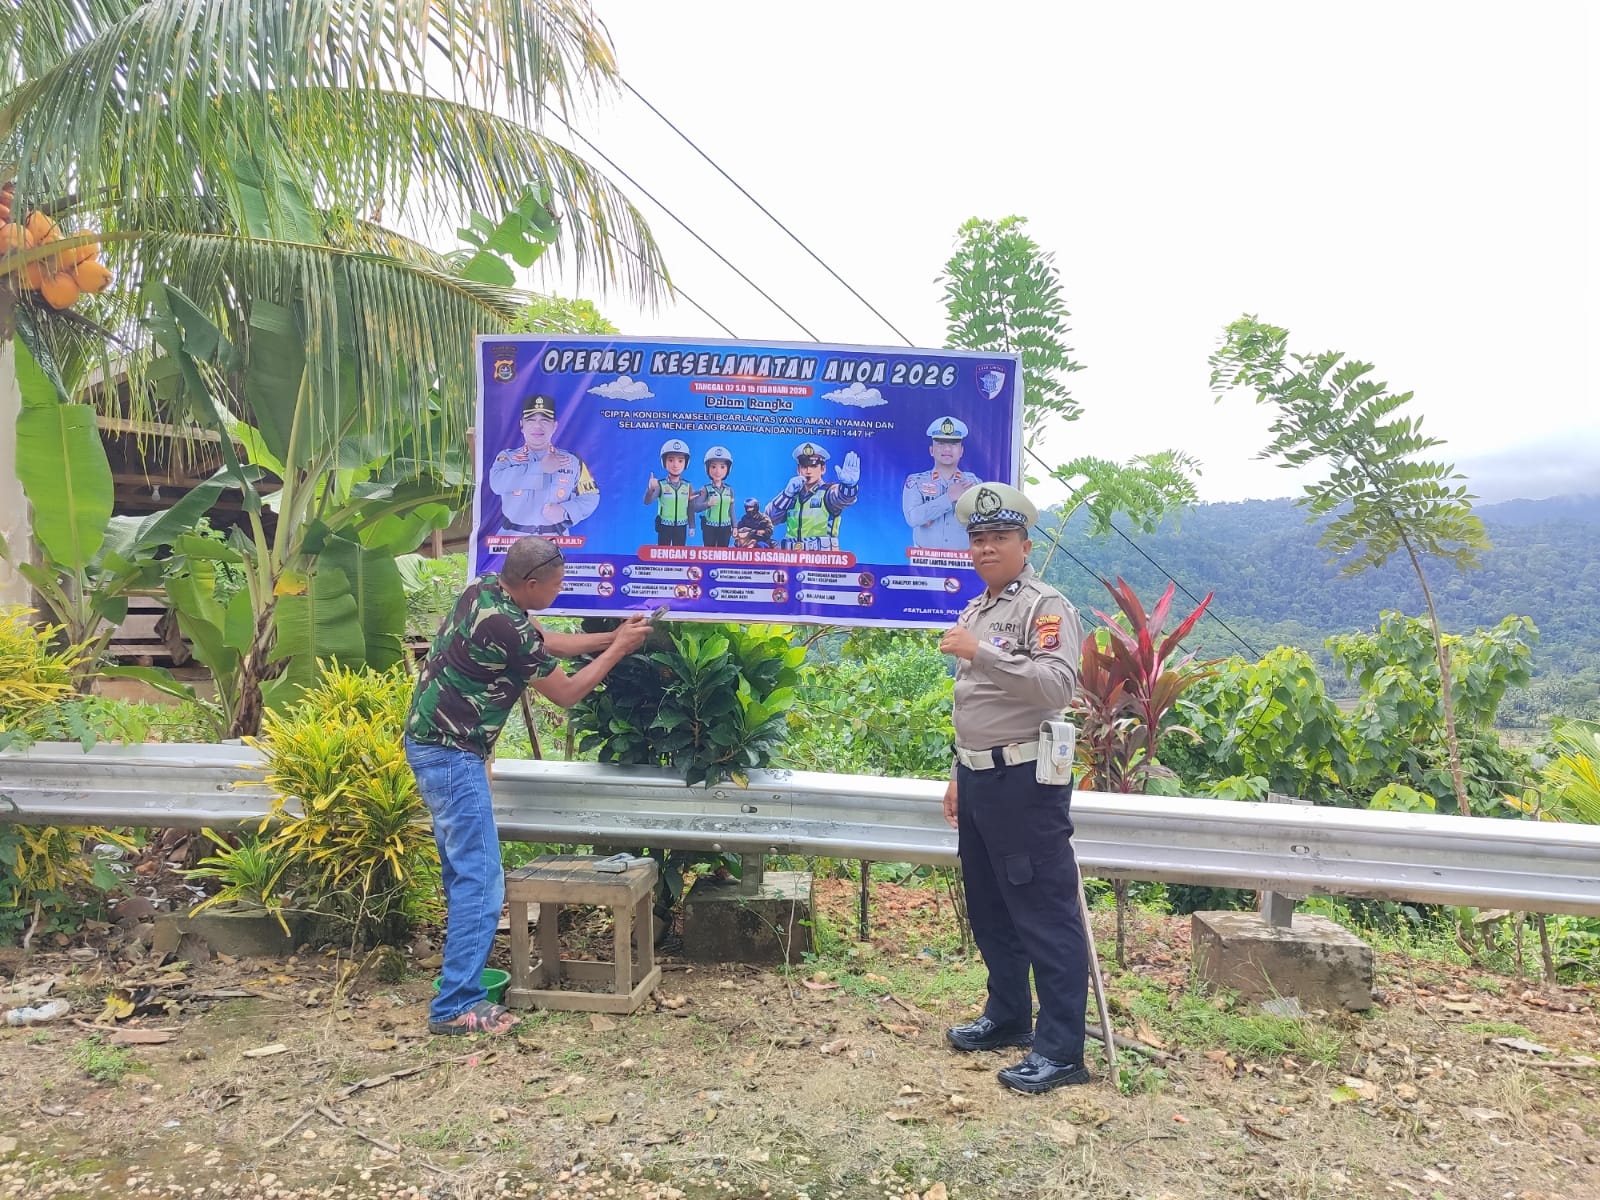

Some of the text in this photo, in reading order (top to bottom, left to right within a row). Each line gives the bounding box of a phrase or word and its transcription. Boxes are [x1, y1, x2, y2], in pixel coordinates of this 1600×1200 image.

[543, 350, 956, 386] OPERASI KESELAMATAN ANOA 2026
[694, 383, 724, 391] TANGGAL
[725, 384, 734, 392] 02
[747, 385, 755, 393] 15
[756, 385, 788, 394] FEBRUARI
[706, 396, 793, 412] Dalam Rangka
[633, 411, 670, 420] KONDISI
[777, 415, 802, 424] YANG
[835, 418, 873, 428] NYAMAN
[875, 420, 894, 429] DAN
[619, 421, 660, 430] SELAMAT
[662, 421, 718, 431] MENJELANG
[719, 424, 771, 434] RAMADHAN
[772, 425, 793, 434] DAN
[794, 426, 816, 435] IDUL
[817, 427, 840, 436] FITRI
[842, 429, 863, 437] 1447
[650, 548, 688, 560] DENGAN
[689, 549, 697, 560] 9
[754, 551, 797, 563] SASARAN
[799, 553, 849, 565] PRIORITAS
[989, 622, 1017, 633] POLRI
